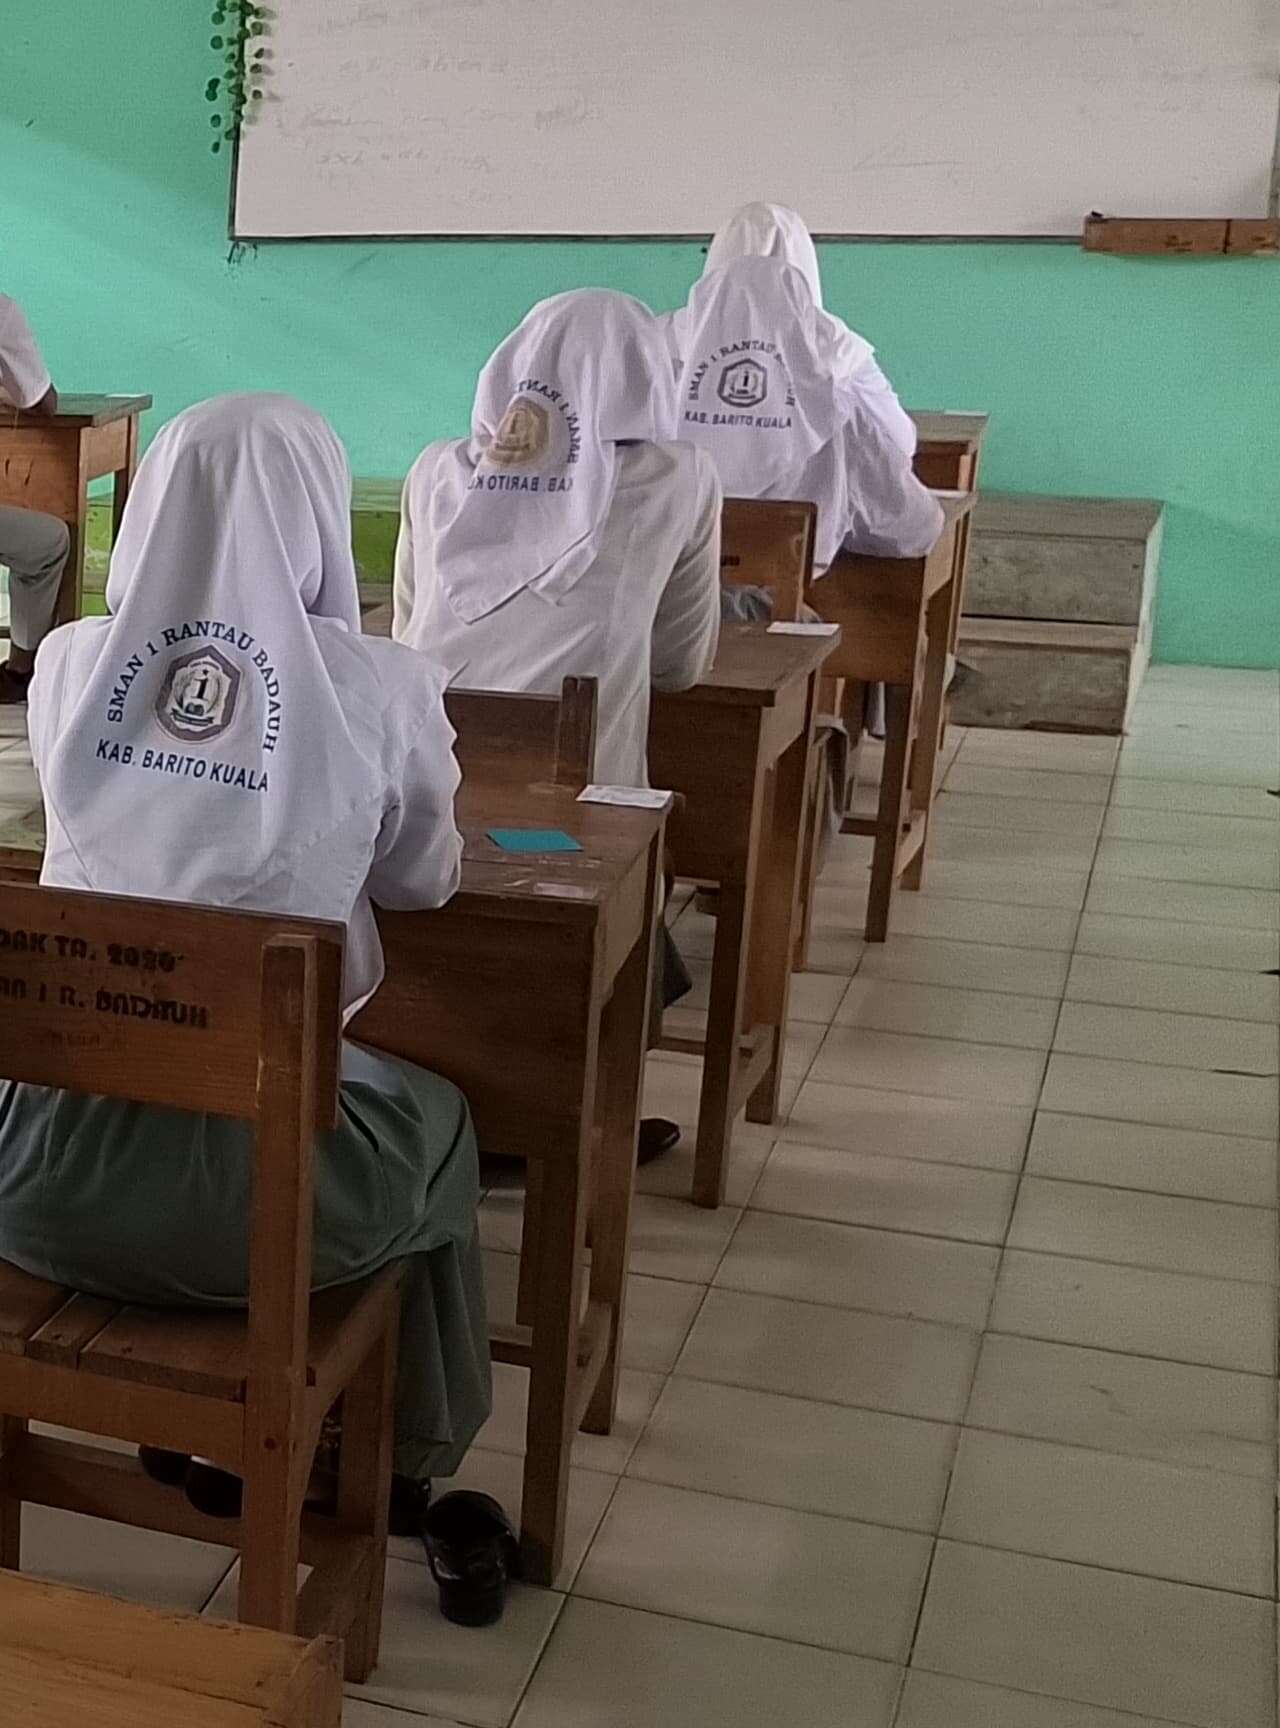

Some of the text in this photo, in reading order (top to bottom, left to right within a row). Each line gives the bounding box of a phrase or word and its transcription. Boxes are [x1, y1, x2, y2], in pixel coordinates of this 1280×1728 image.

[712, 413, 753, 425] BARITO
[755, 416, 792, 429] KUALA
[108, 620, 281, 753] SMAN 1 RANTAU BADAUH
[96, 738, 269, 793] KAB. BARITO KUALA
[96, 988, 209, 1029] BADAUH
